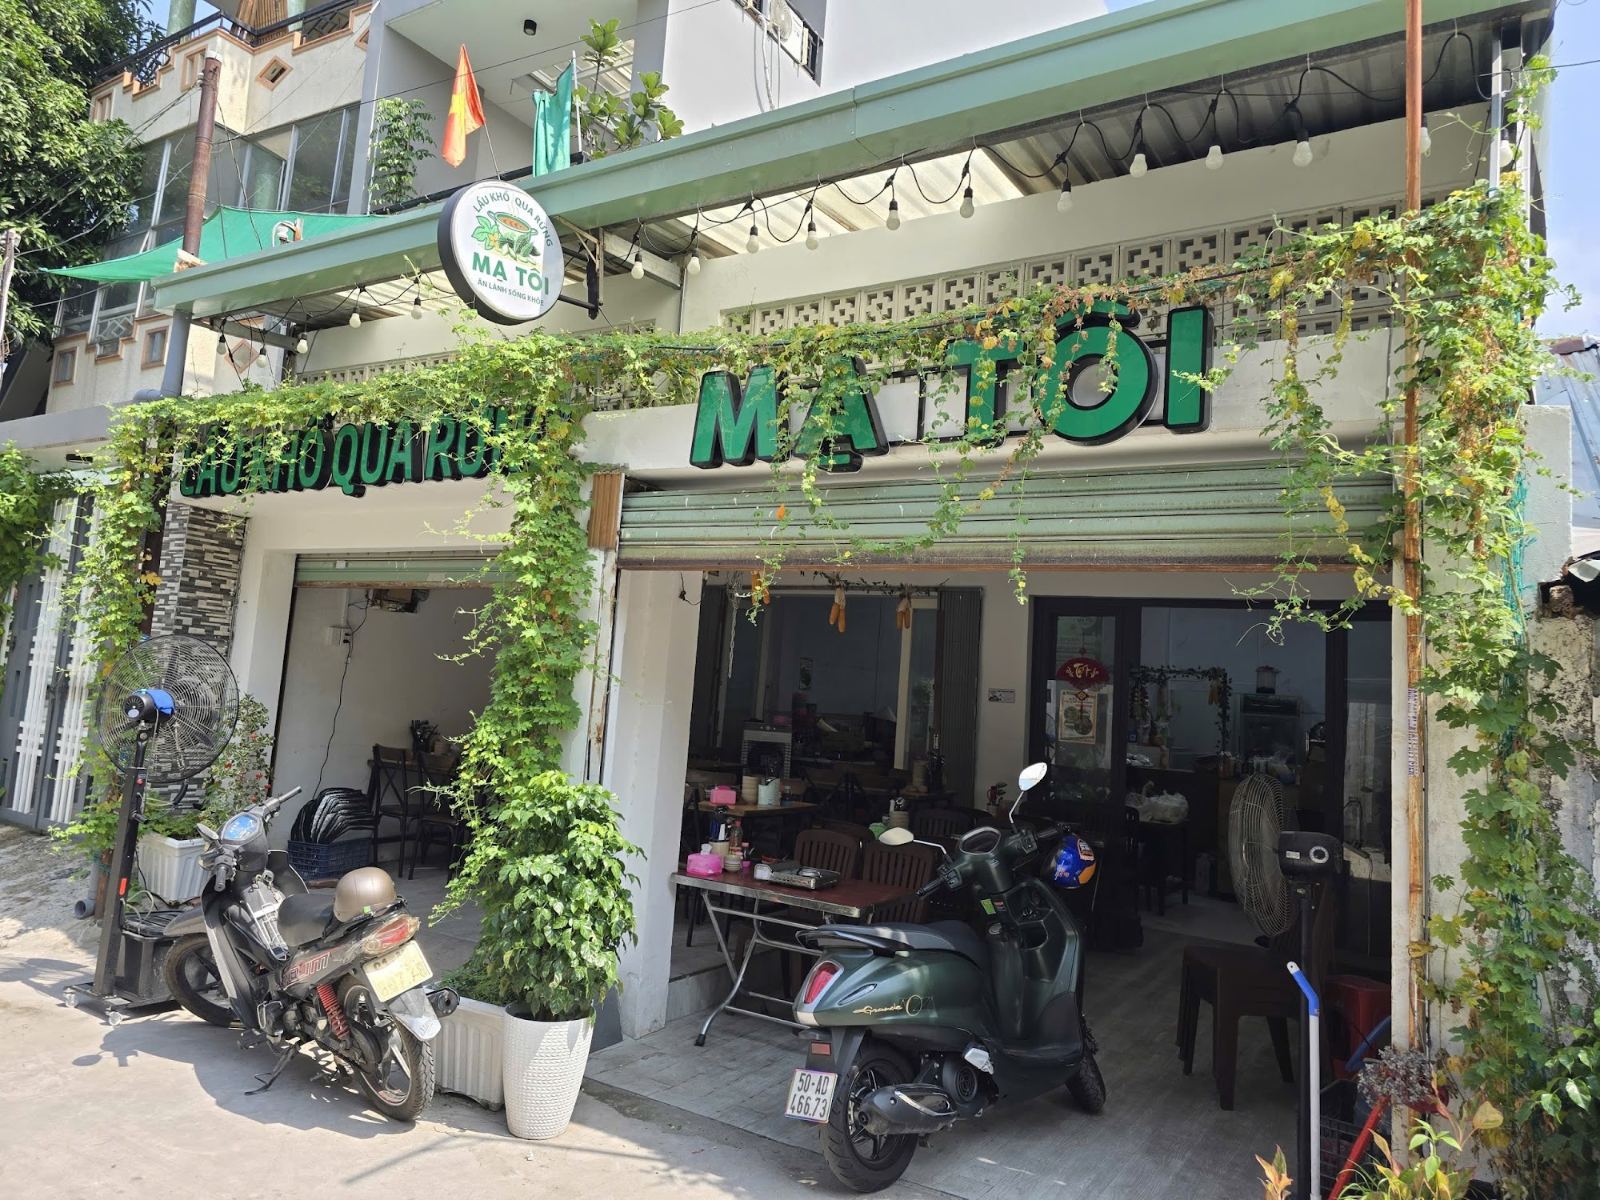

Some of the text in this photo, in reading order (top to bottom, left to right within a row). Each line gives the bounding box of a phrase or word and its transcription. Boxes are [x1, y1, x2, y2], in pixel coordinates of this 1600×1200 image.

[515, 197, 534, 217] QUA
[472, 252, 549, 295] MẠ TÔI
[690, 297, 1211, 472] MẠ TÔI
[332, 413, 416, 497] QUA
[797, 1073, 829, 1095] 50-AD
[790, 1094, 828, 1118] 466.73
